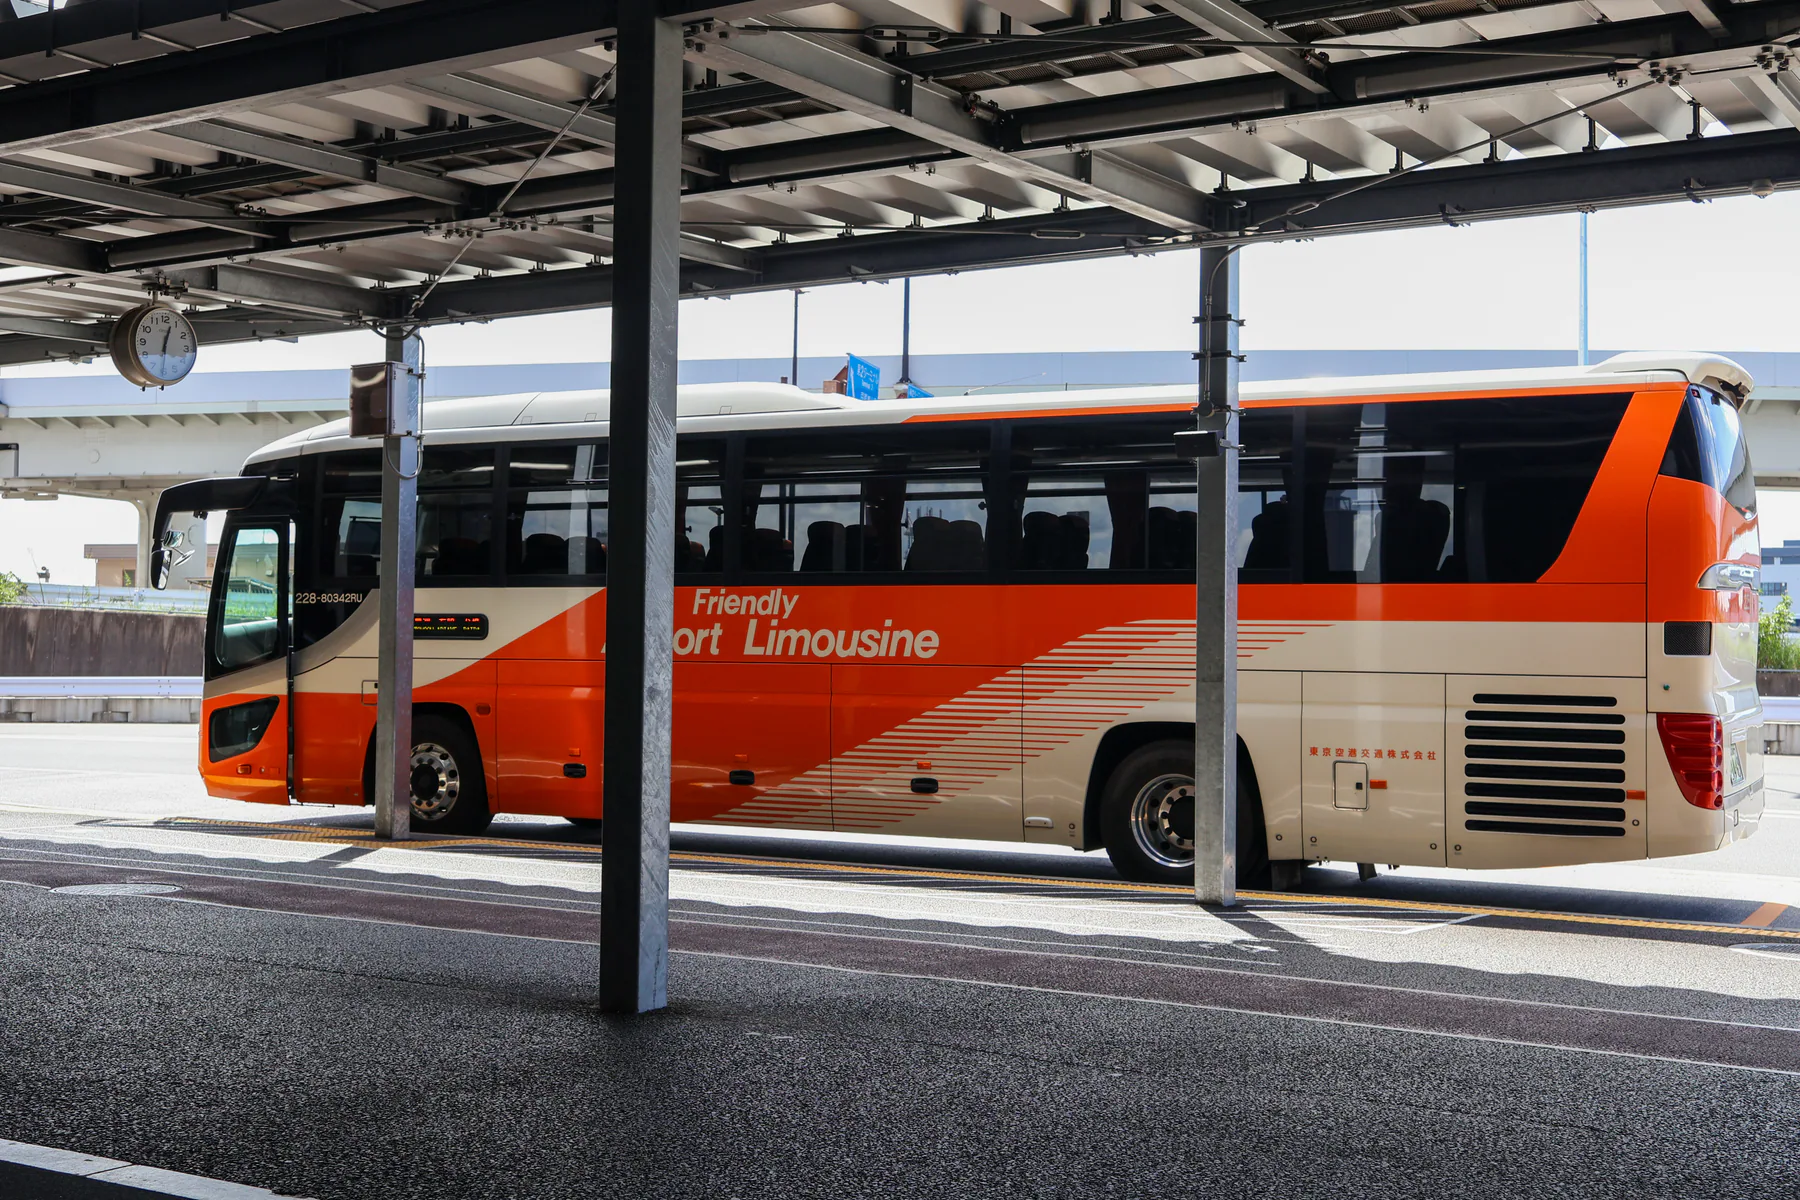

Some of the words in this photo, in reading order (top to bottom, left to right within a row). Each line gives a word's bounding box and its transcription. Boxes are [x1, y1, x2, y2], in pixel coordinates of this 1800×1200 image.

[151, 317, 158, 325] 11
[161, 315, 170, 324] 12
[295, 592, 363, 604] 228-80342RU
[692, 588, 799, 619] Friendly
[743, 618, 940, 659] Limousine
[1309, 746, 1437, 761] 東京空港交通株式会社
